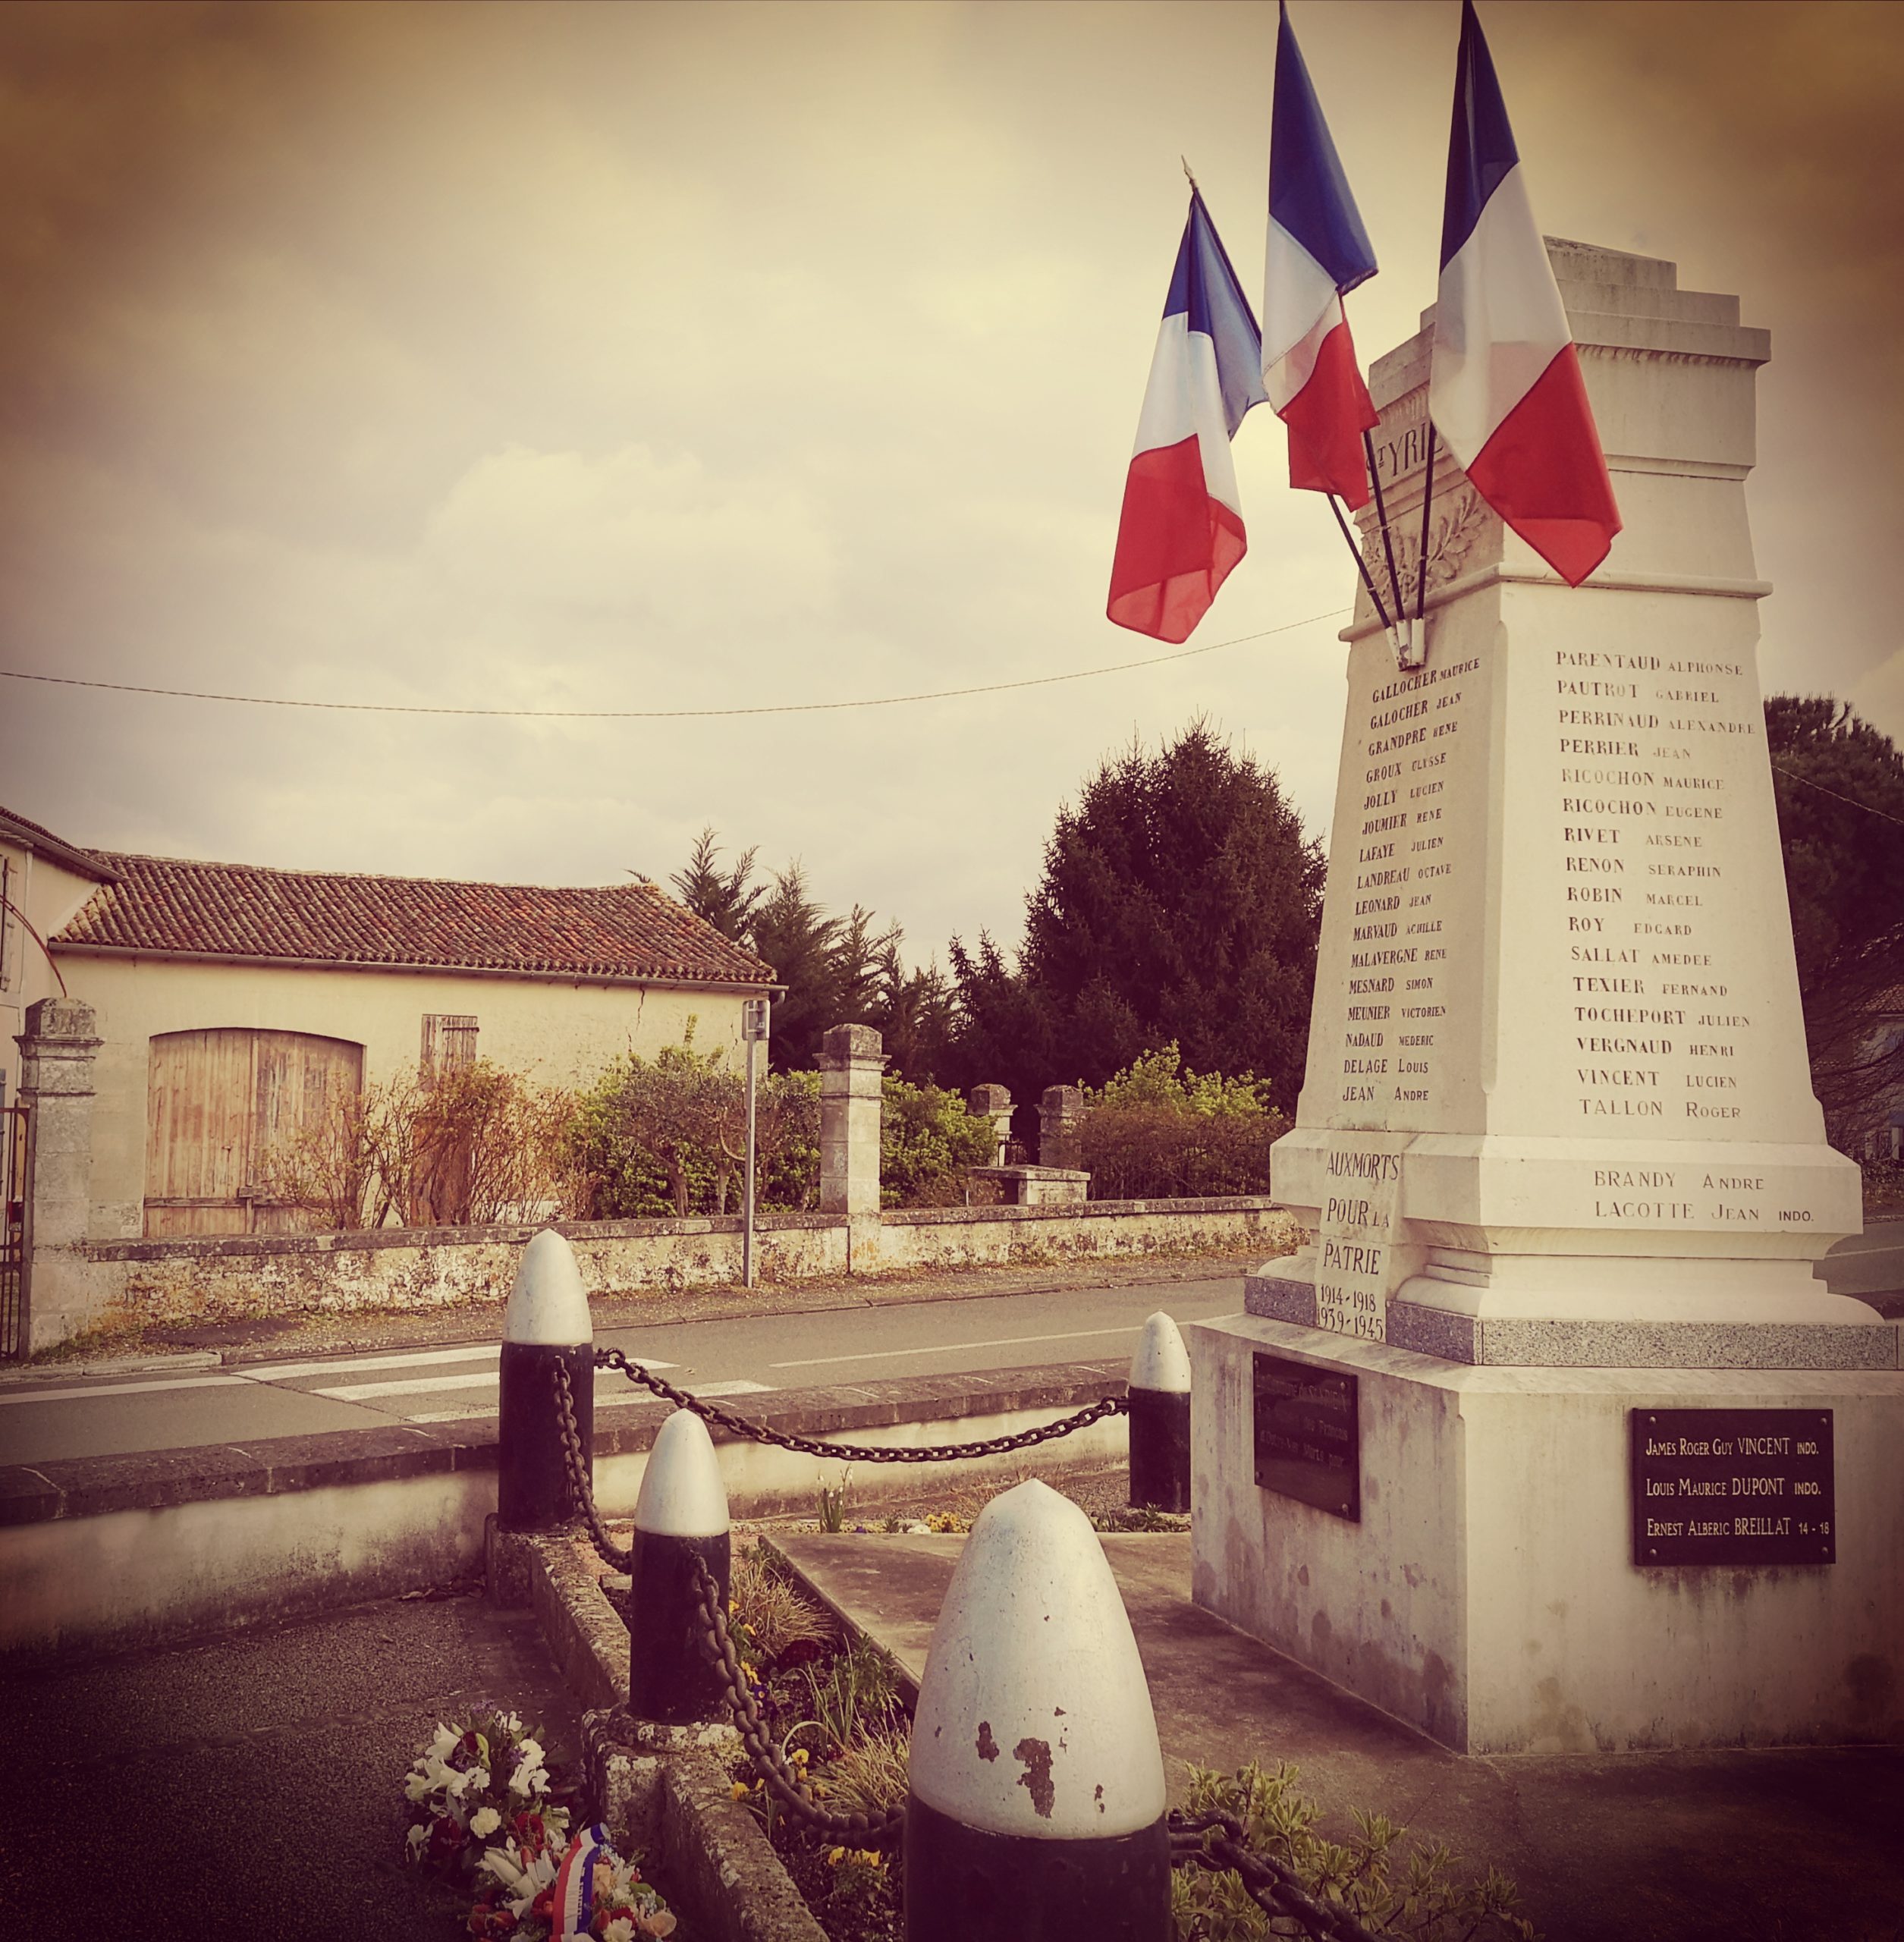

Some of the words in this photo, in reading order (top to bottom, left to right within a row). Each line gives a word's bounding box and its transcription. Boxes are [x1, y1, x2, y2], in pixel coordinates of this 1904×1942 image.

[1557, 652, 1661, 671] PARENTAUD
[1668, 661, 1743, 675] ALPHONSE
[1372, 670, 1437, 703] GALLOCHER
[1440, 658, 1479, 680] MAURICE
[1557, 680, 1639, 698] PAUTROT
[1656, 690, 1719, 702] GABRIEL
[1371, 700, 1428, 729] GALOCHER
[1437, 692, 1461, 709] JEAN
[1559, 710, 1659, 728] PERRINAUD
[1669, 721, 1755, 734] ALEXANDRE
[1368, 727, 1426, 756] GRANDPRE
[1560, 739, 1639, 756] PERRIER
[1653, 747, 1691, 759] JEAN
[1366, 762, 1402, 783] GROUX
[1562, 768, 1654, 785] RICOCHON
[1664, 777, 1724, 790] MAURICE
[1364, 790, 1398, 809] JOLLY
[1410, 781, 1444, 798] LUCIEN
[1563, 798, 1657, 815] RICOCHON
[1666, 806, 1723, 819] EUGENE
[1362, 813, 1407, 834] JOUMIER
[1417, 809, 1441, 823] RENE
[1564, 828, 1620, 843] RIVET
[1646, 834, 1702, 847] ARSENE
[1359, 843, 1395, 863] LAFAYE
[1412, 837, 1444, 852] JULIEN
[1357, 867, 1410, 889] LANDREAU
[1419, 864, 1451, 878] OCTAVE
[1566, 857, 1624, 872] RENON
[1648, 865, 1721, 877] SERAPHIN
[1356, 896, 1400, 916] LEONARD
[1409, 894, 1431, 907] JEAN
[1567, 887, 1622, 902] ROBIN
[1646, 894, 1703, 907] MARCEL
[1353, 922, 1397, 941] MARVAUD
[1406, 920, 1442, 935] ACHILLE
[1569, 917, 1604, 932] ROY
[1634, 923, 1692, 935] EDGARD
[1351, 948, 1418, 968] MALAVERGNE
[1425, 949, 1447, 961] RENE
[1571, 947, 1640, 963] SALLAT
[1652, 954, 1711, 966] AMEDEE
[1349, 978, 1394, 995] MESNARD
[1406, 978, 1433, 990] SIMON
[1573, 977, 1645, 994] TEXIER
[1663, 984, 1727, 996] FERNAND
[1348, 1006, 1390, 1020] MEUNIER
[1402, 1006, 1446, 1018] VICTORIEN
[1575, 1007, 1686, 1024] TOCHEPORT
[1698, 1015, 1750, 1027] JULIEN
[1346, 1032, 1384, 1047] NADAUD
[1399, 1035, 1434, 1046] MEDERIC
[1577, 1038, 1672, 1054] VERGNAUD
[1689, 1045, 1735, 1057] HENRI
[1344, 1059, 1387, 1073] DELAGE
[1578, 1069, 1660, 1086] VINCENT
[1686, 1075, 1736, 1088] LUCIEN
[1343, 1086, 1375, 1101] JEAN
[1579, 1099, 1663, 1115] TALLON
[1595, 1171, 1676, 1187] BRANDY
[1327, 1198, 1368, 1226] POUR
[1372, 1211, 1389, 1227] LA
[1596, 1202, 1695, 1219] LACOTTE
[1323, 1241, 1381, 1274] PATRIE
[1738, 1438, 1790, 1455] VINCENT
[1733, 1478, 1785, 1495] DUPONT
[1735, 1518, 1790, 1535] BREILLAT
